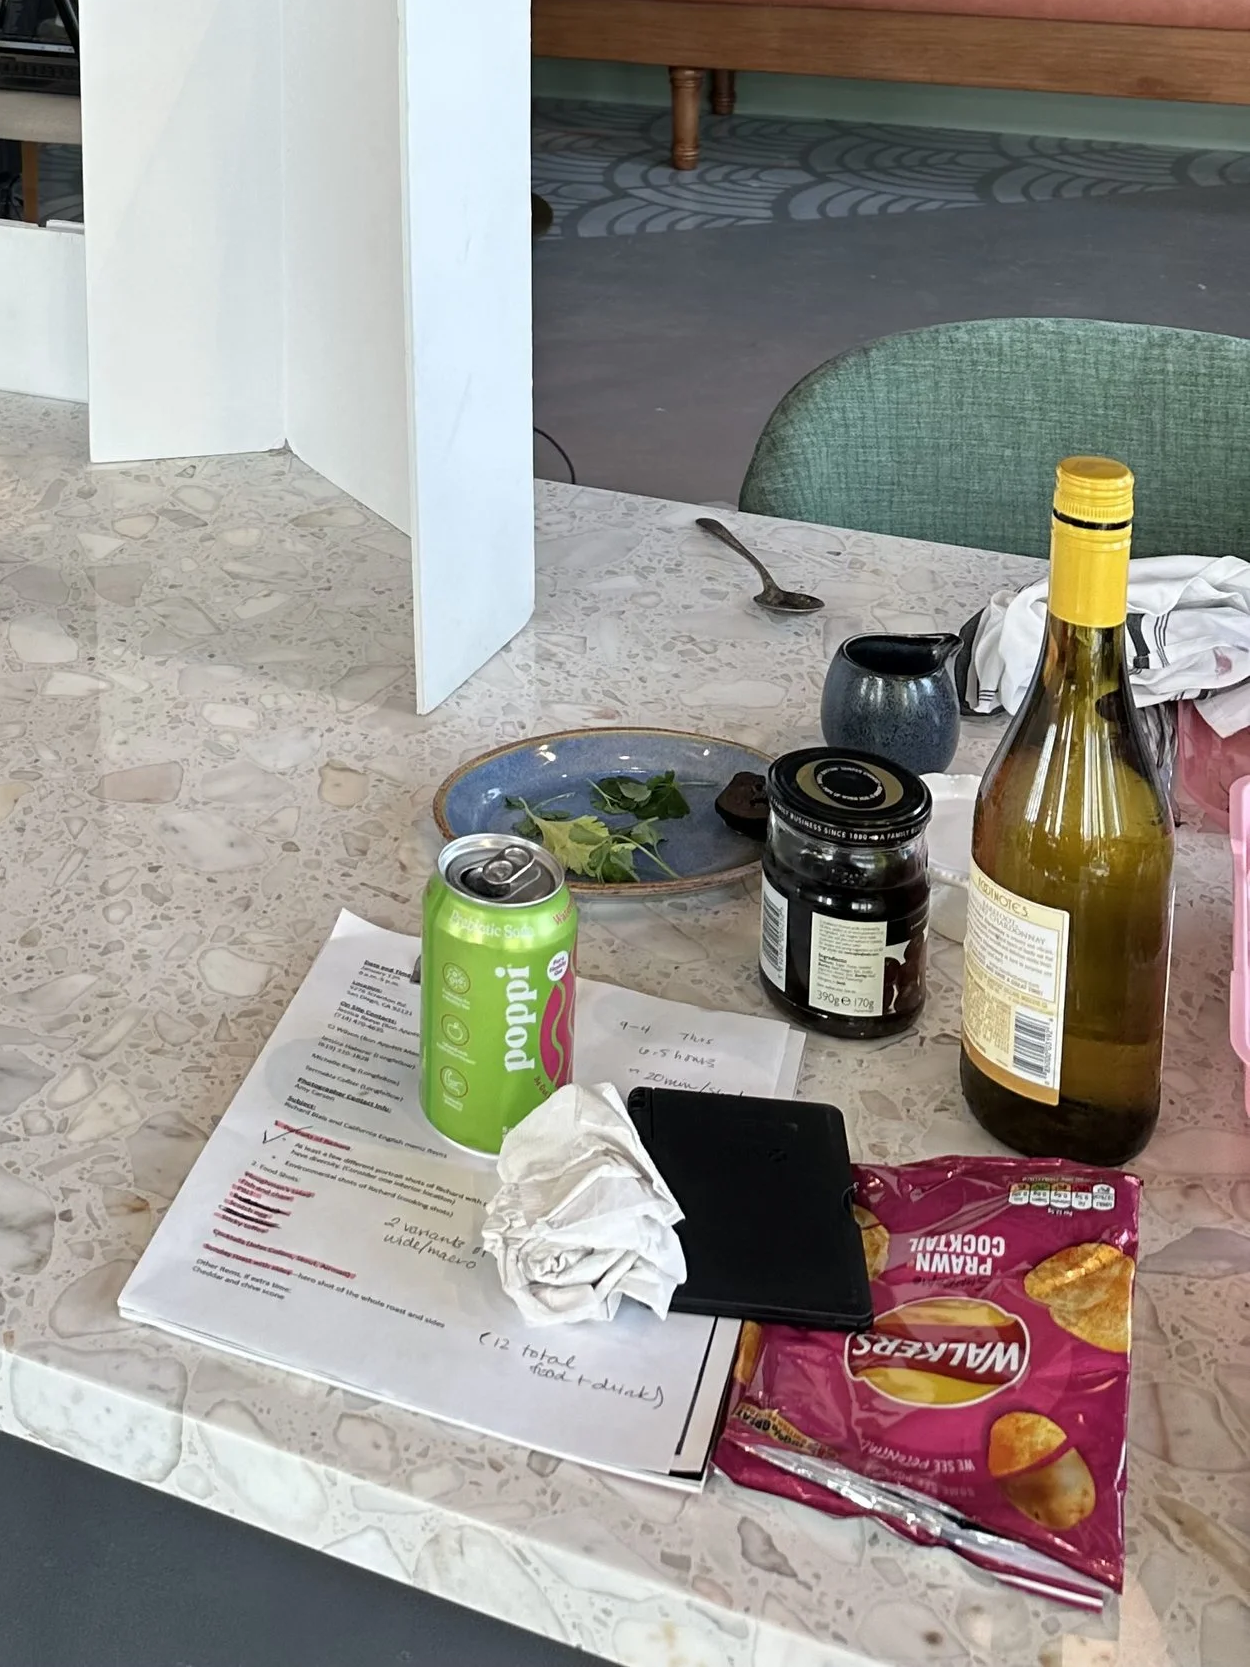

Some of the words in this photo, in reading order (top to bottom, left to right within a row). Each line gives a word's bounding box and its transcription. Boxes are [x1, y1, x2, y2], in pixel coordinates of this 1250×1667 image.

[790, 812, 822, 832] BUSINESS
[824, 828, 846, 839] SINCE
[887, 829, 910, 841] FAMILY
[450, 909, 501, 938] Prebiotic
[503, 923, 535, 940] Soda
[360, 965, 385, 977] January
[363, 959, 380, 970] Date
[380, 964, 394, 974] and
[347, 990, 358, 998] San
[817, 990, 840, 1007] 390g
[854, 997, 875, 1011] 170g
[336, 1006, 359, 1018] Jessica
[350, 1004, 364, 1014] Site
[365, 1010, 396, 1025] Contacts:
[494, 965, 537, 1072] poppi
[321, 1035, 342, 1047] Jessica
[311, 1052, 339, 1067] Michelle
[674, 1050, 716, 1069] hours
[294, 1084, 310, 1094] Amy
[297, 1077, 346, 1099] Photographer
[346, 1093, 374, 1108] Contact
[287, 1095, 316, 1111] Subject:
[284, 1102, 310, 1116] Richard
[328, 1117, 342, 1127] and
[343, 1121, 377, 1138] California
[378, 1133, 403, 1147] English
[404, 1141, 426, 1153] menu
[259, 1164, 278, 1176] Food
[290, 1149, 308, 1159] have
[309, 1155, 340, 1171] diversity.
[341, 1164, 377, 1182] (Consider
[377, 1176, 393, 1185] one
[393, 1180, 422, 1194] interior
[422, 1188, 456, 1207] location)
[303, 1145, 321, 1155] least
[328, 1152, 342, 1162] few
[342, 1157, 374, 1172] different
[375, 1167, 404, 1182] portrait
[405, 1176, 425, 1187] shots
[426, 1182, 436, 1190] of
[435, 1185, 464, 1200] Richard
[464, 1194, 481, 1206] with
[284, 1158, 336, 1182] Environmental
[337, 1175, 356, 1187] shots
[357, 1181, 366, 1190] of
[366, 1184, 395, 1199] Richard
[396, 1194, 428, 1211] (cooking
[429, 1204, 454, 1219] shots)
[221, 1213, 243, 1227] Sticky
[384, 1217, 401, 1227] 2
[404, 1223, 466, 1249] variants
[383, 1234, 477, 1270] wide/macro
[909, 1234, 1006, 1257] COCKTAIL
[196, 1258, 218, 1270] Other
[219, 1265, 241, 1279] items,
[242, 1273, 250, 1281] if
[251, 1276, 270, 1288] extra
[915, 1252, 993, 1276] PRAWN
[192, 1265, 225, 1281] Cheddar
[225, 1277, 240, 1287] and
[240, 1281, 262, 1293] chive
[262, 1287, 285, 1301] scone
[202, 1243, 231, 1258] Sunday
[252, 1258, 270, 1270] with
[317, 1279, 334, 1291] shot
[334, 1285, 346, 1294] of
[346, 1289, 360, 1299] the
[360, 1294, 385, 1308] whole
[386, 1303, 406, 1315] roast
[407, 1309, 422, 1321] and
[424, 1317, 445, 1330] sides
[522, 1344, 576, 1370] total
[850, 1330, 1020, 1374] WALKERS
[530, 1362, 569, 1382] food
[934, 1458, 955, 1473] SEE
[956, 1458, 975, 1472] WE
